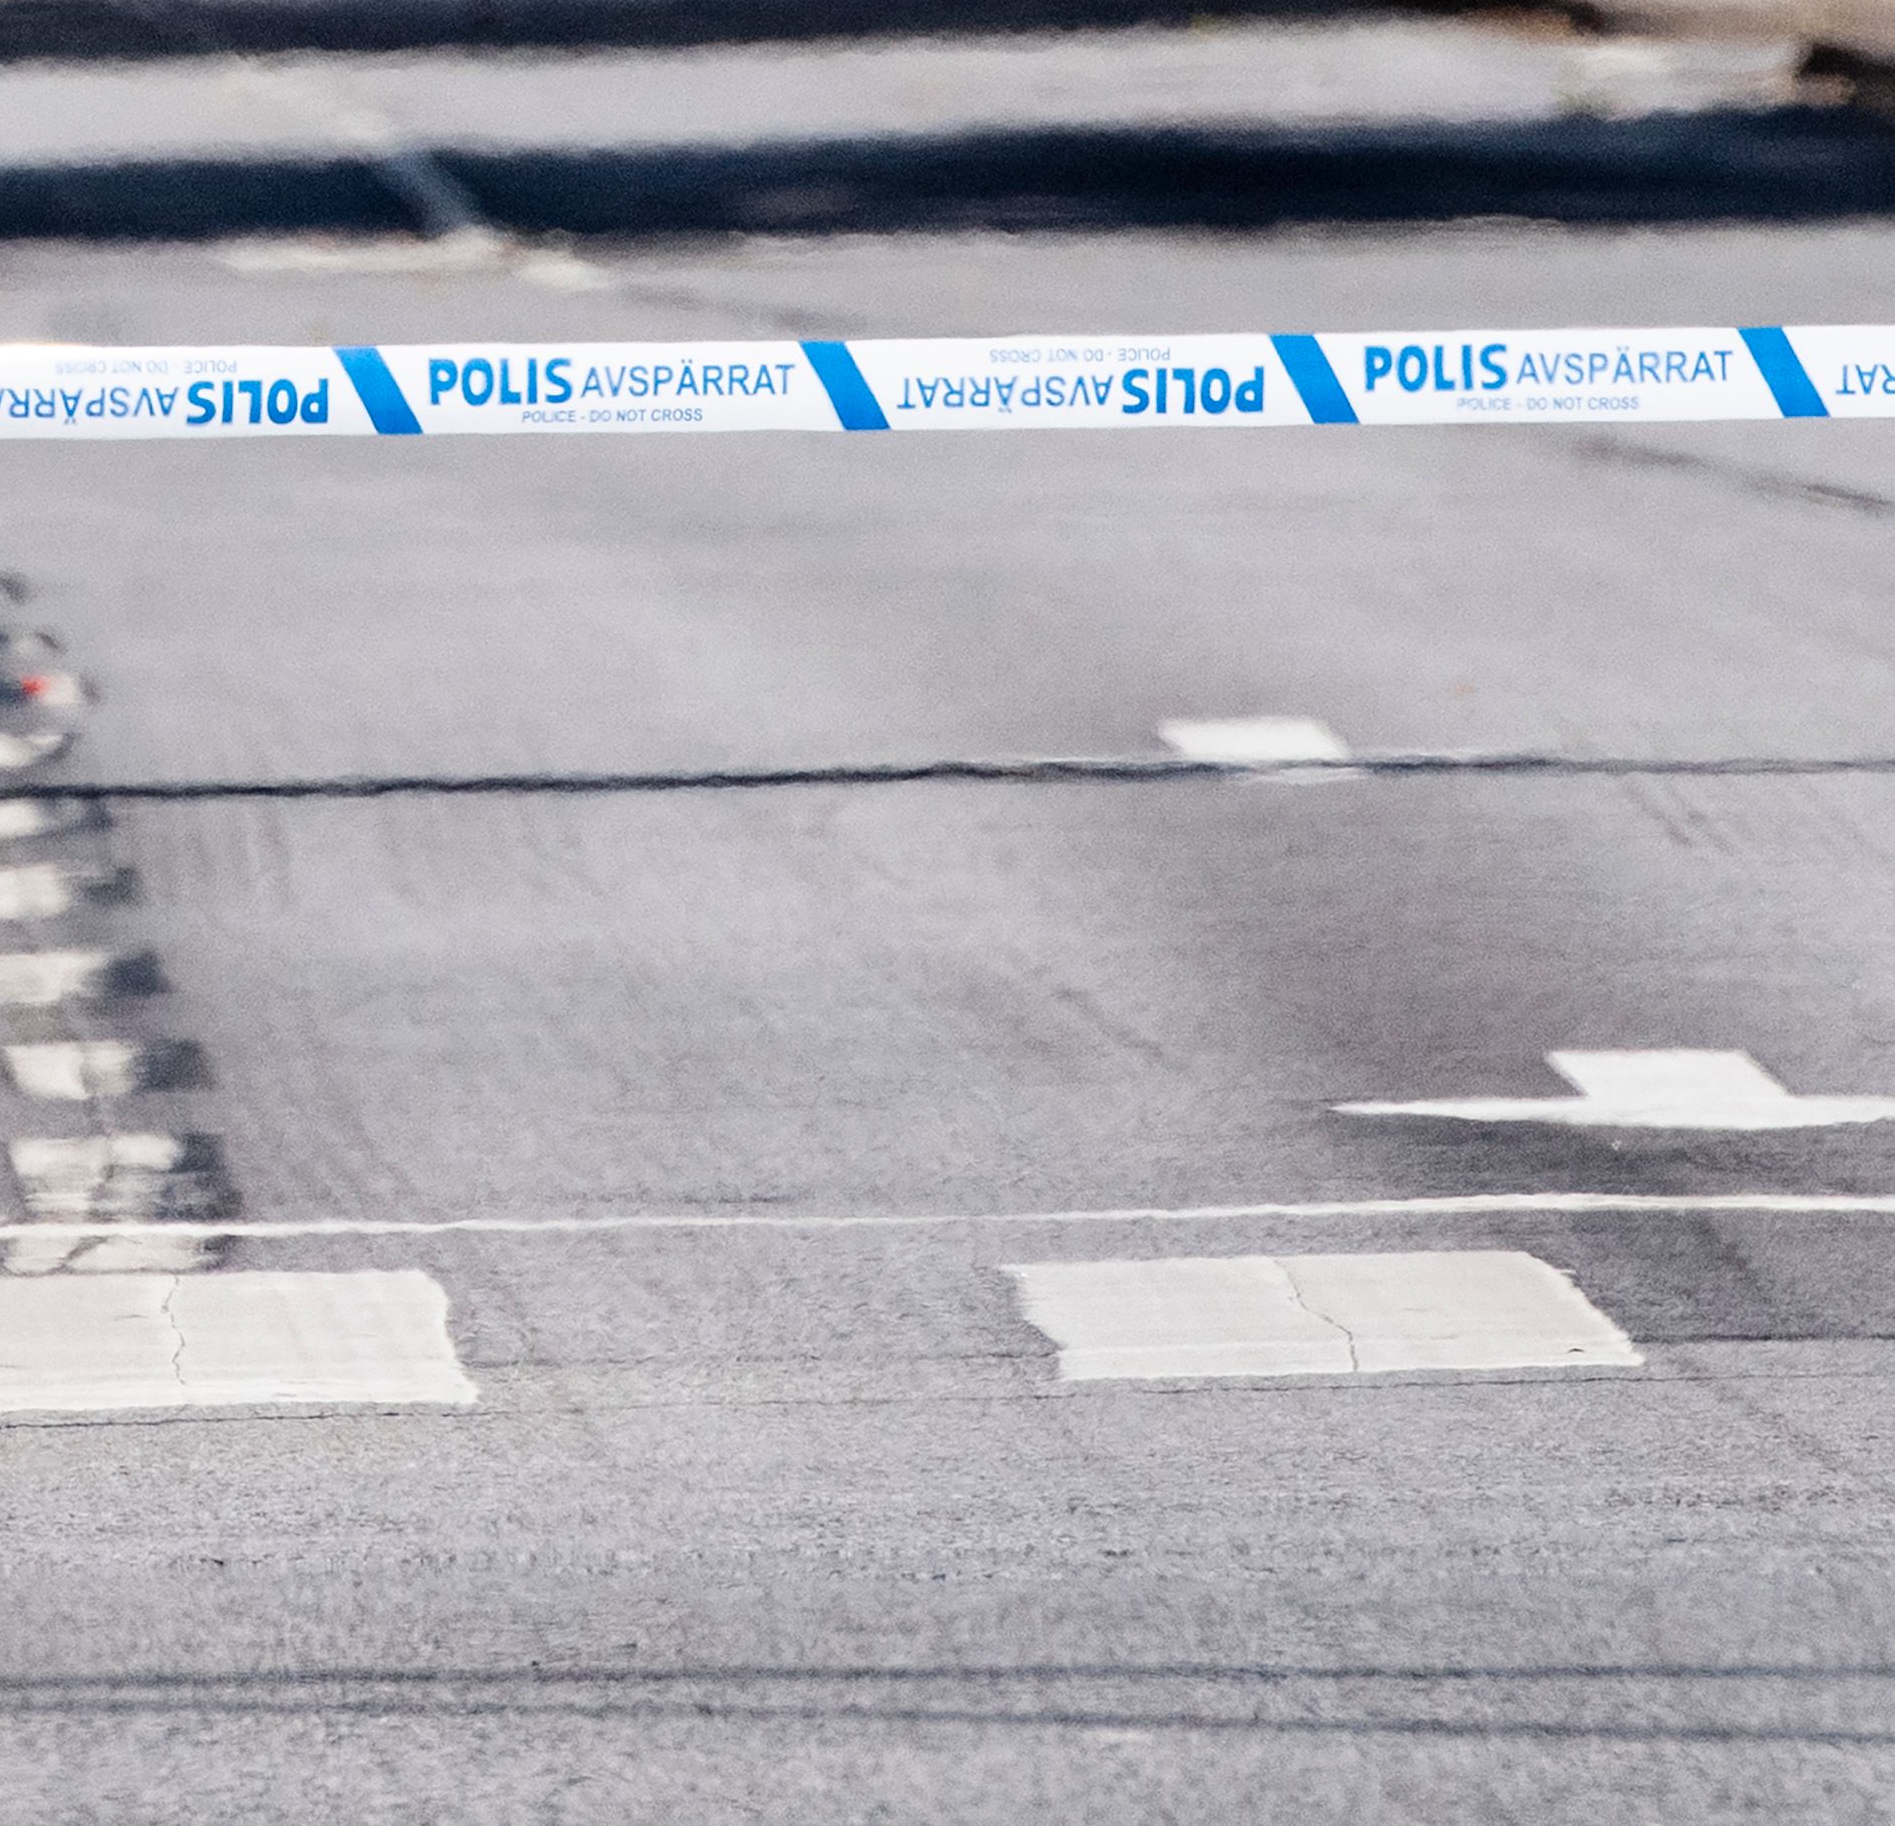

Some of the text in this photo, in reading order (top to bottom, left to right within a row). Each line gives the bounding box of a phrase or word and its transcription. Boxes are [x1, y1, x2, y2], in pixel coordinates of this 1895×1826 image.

[989, 349, 1042, 364] CROSS
[1048, 348, 1078, 363] NOT
[1082, 348, 1105, 363] DO
[1117, 347, 1171, 362] POLICE
[55, 361, 107, 374] CROSS
[110, 361, 140, 374] NOT
[146, 361, 169, 374] DO
[184, 361, 238, 374] POLICE
[1364, 343, 1733, 393] POLIS AVSPÄRRAT
[428, 357, 795, 406] POLIS AVSPÄRRAT
[896, 366, 1265, 414] POLIS AVSPÄRRAT
[186, 377, 329, 425] POLIS
[1457, 397, 1511, 411] POLICE
[1526, 397, 1548, 411] DO
[1553, 397, 1583, 410] NOT
[1587, 396, 1640, 410] CROSS
[521, 409, 576, 423] POLICE
[589, 409, 611, 422] DO
[616, 409, 646, 422] NOT
[650, 408, 703, 422] CROSS
